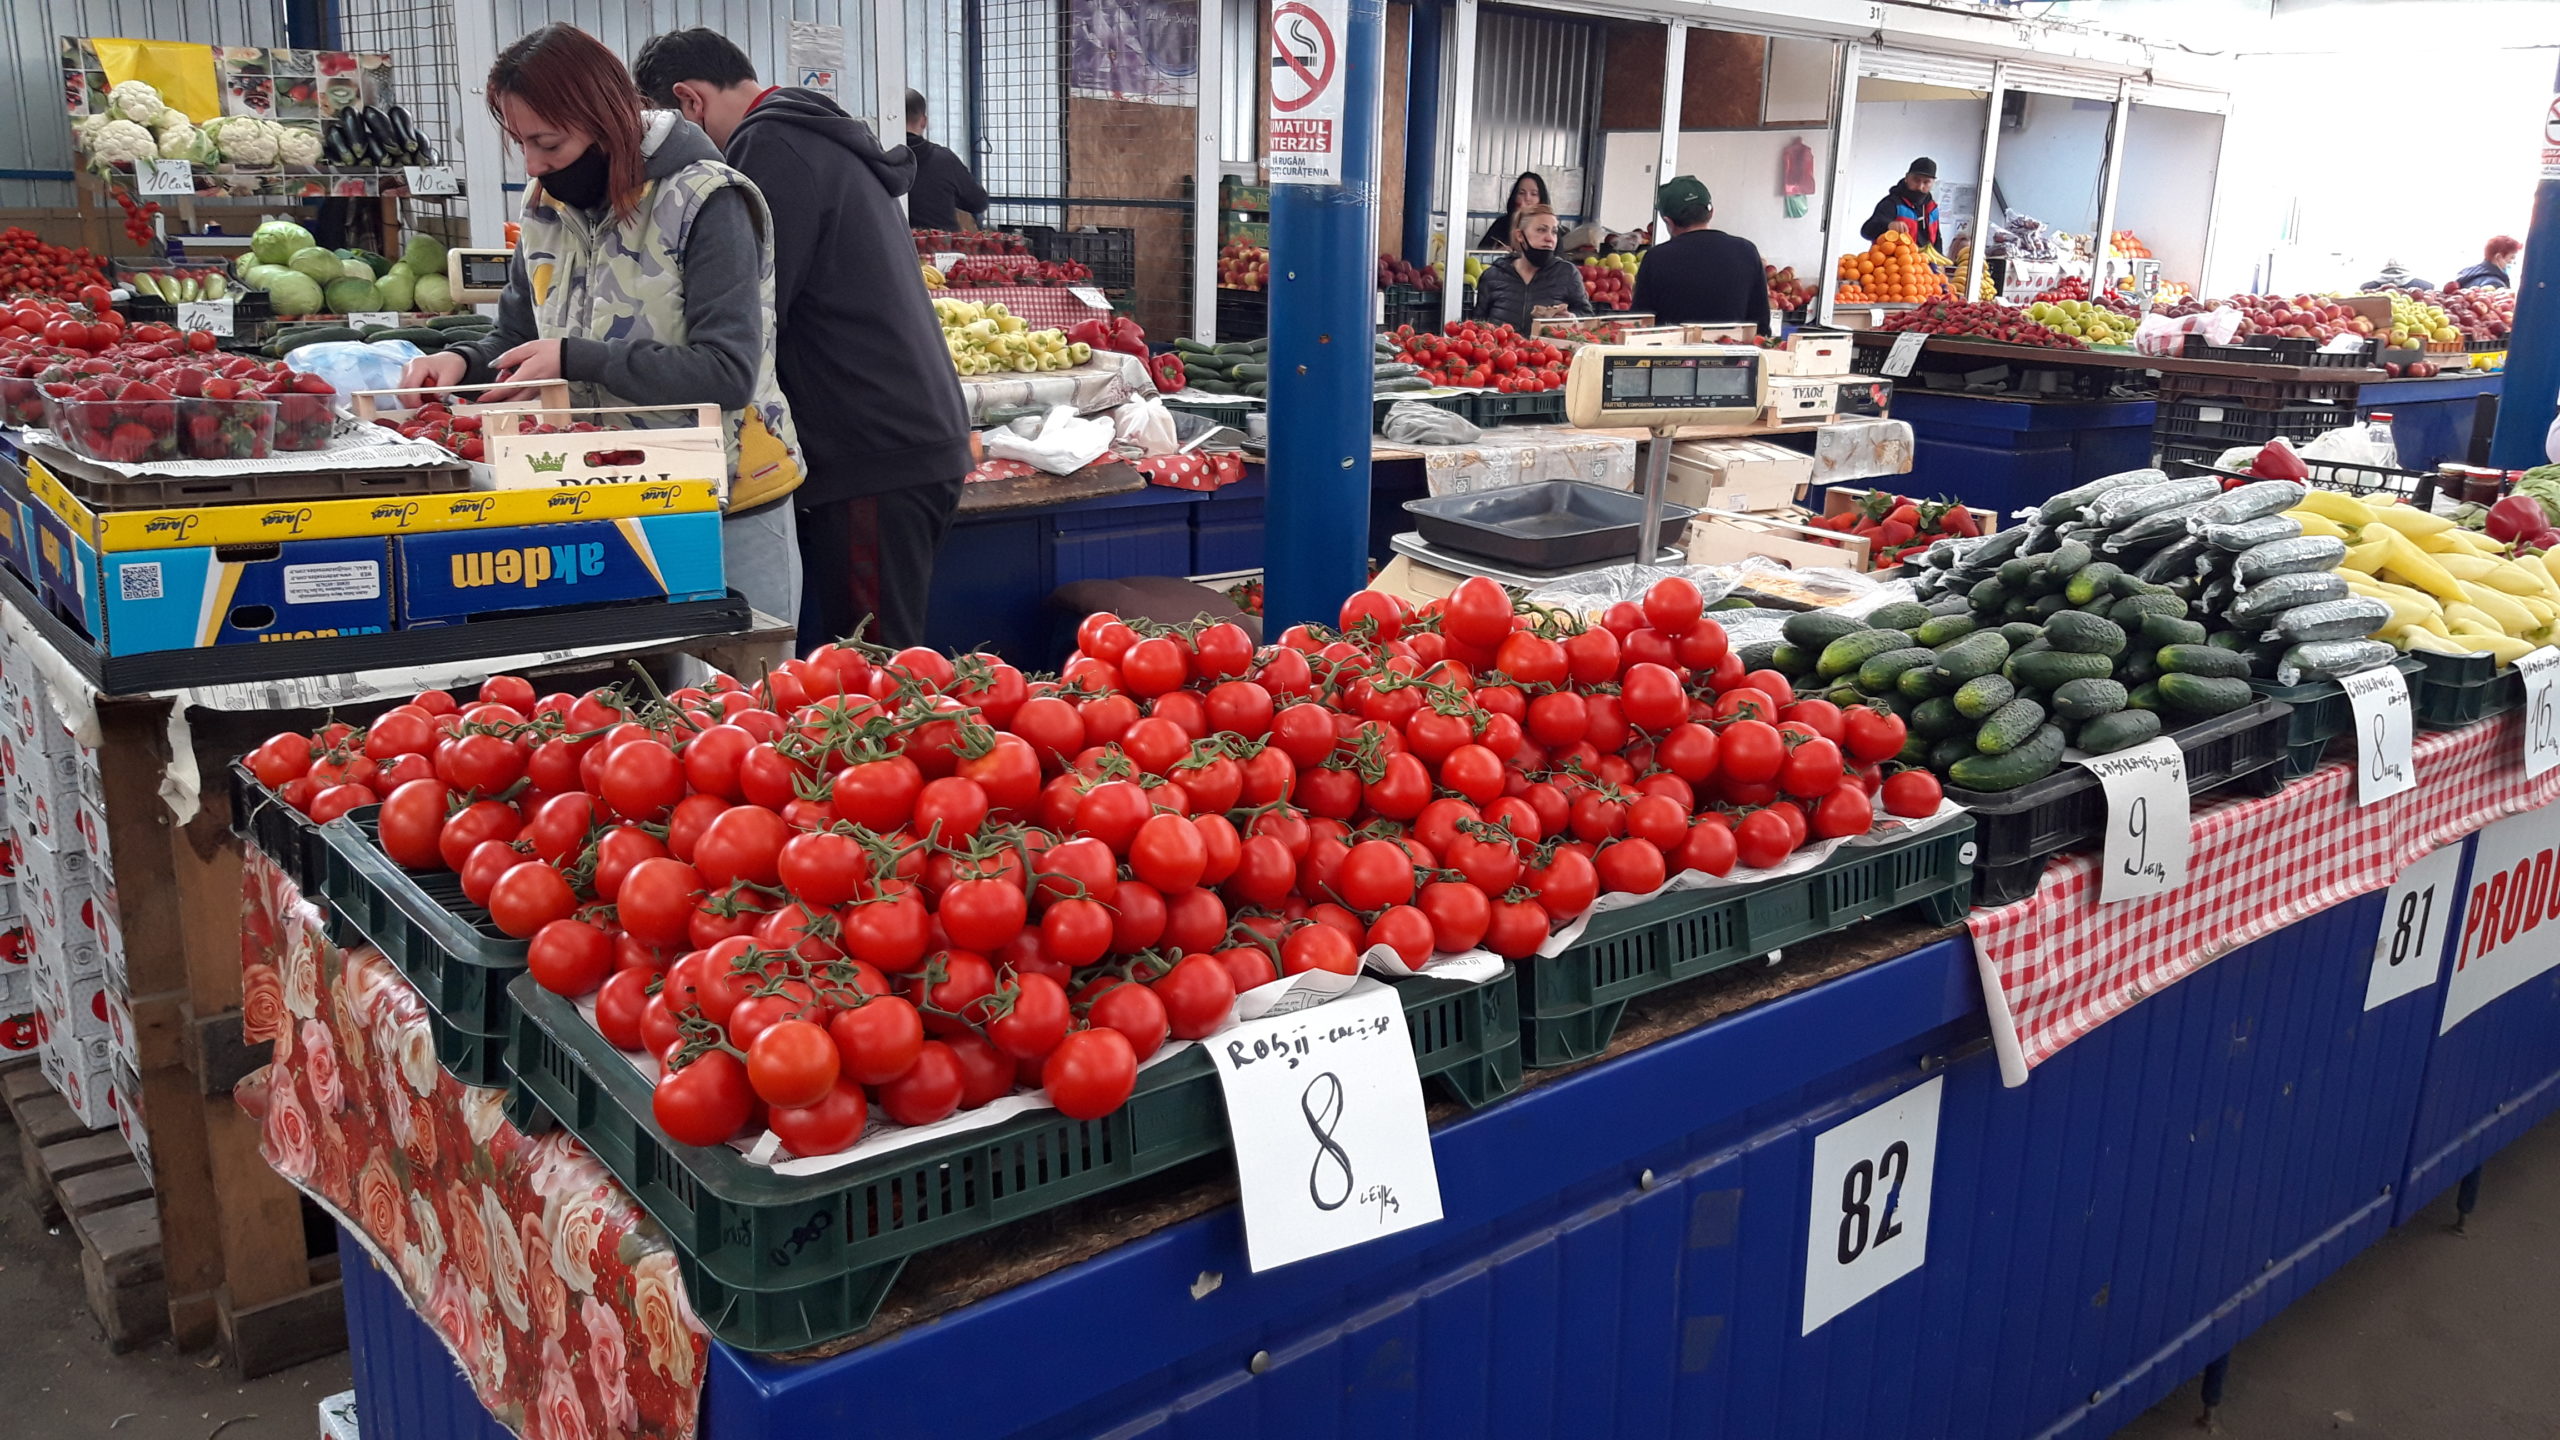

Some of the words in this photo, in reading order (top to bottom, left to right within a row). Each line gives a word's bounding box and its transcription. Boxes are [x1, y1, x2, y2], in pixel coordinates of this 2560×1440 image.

[1869, 7, 1880, 20] 31
[2018, 30, 2028, 42] 32
[415, 174, 432, 192] 10
[1792, 385, 1824, 399] ROYAL
[451, 541, 605, 589] akdem
[2371, 713, 2385, 782] 8
[2530, 679, 2552, 754] 15
[2124, 796, 2147, 876] 9
[2389, 883, 2436, 967] 81
[1301, 1071, 1354, 1211] 8
[1837, 1140, 1909, 1265] 82
